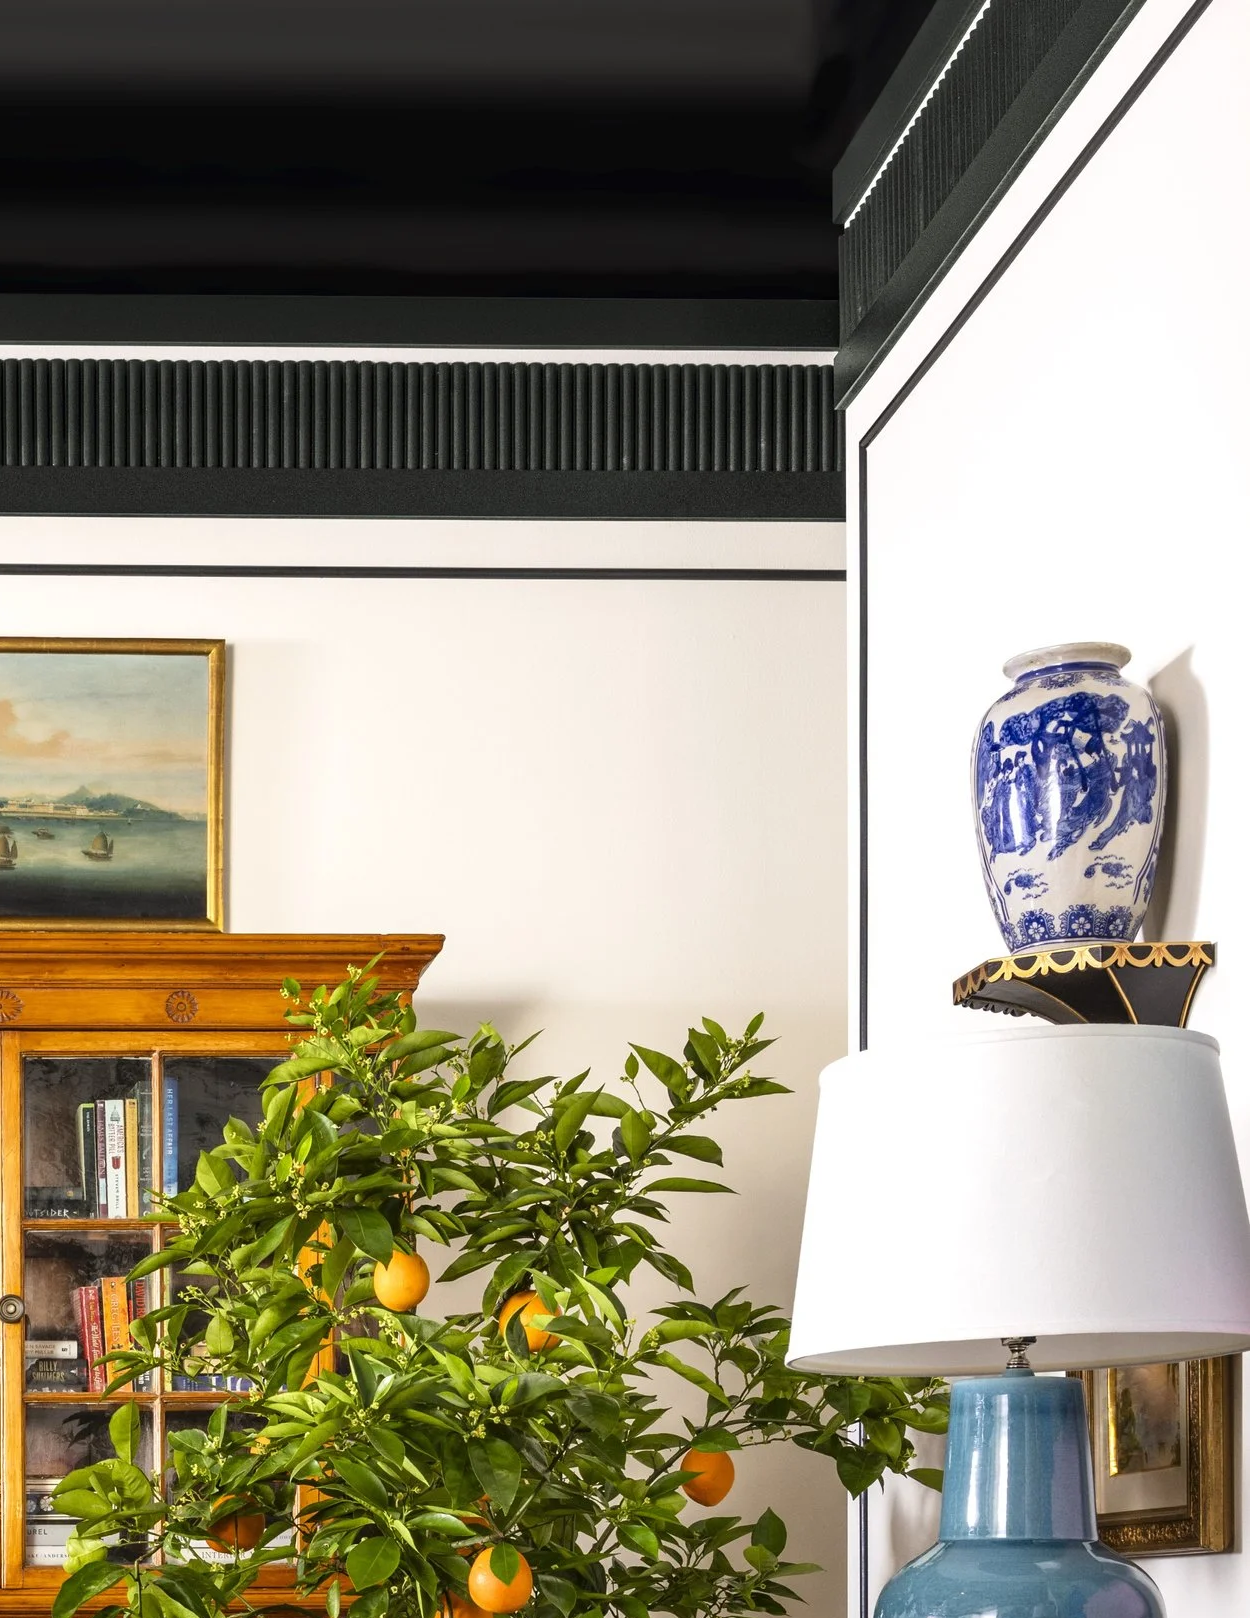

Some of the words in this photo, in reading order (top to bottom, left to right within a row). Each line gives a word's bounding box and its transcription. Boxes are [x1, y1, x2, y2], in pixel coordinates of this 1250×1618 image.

[166, 1088, 174, 1106] HER
[166, 1106, 174, 1131] LAST
[25, 1208, 70, 1218] UTSIDER
[135, 1282, 146, 1307] DAVID
[110, 1293, 120, 1319] GREG
[112, 1322, 121, 1342] ILES
[38, 1361, 58, 1371] BILLY
[32, 1372, 65, 1381] SUMMERS
